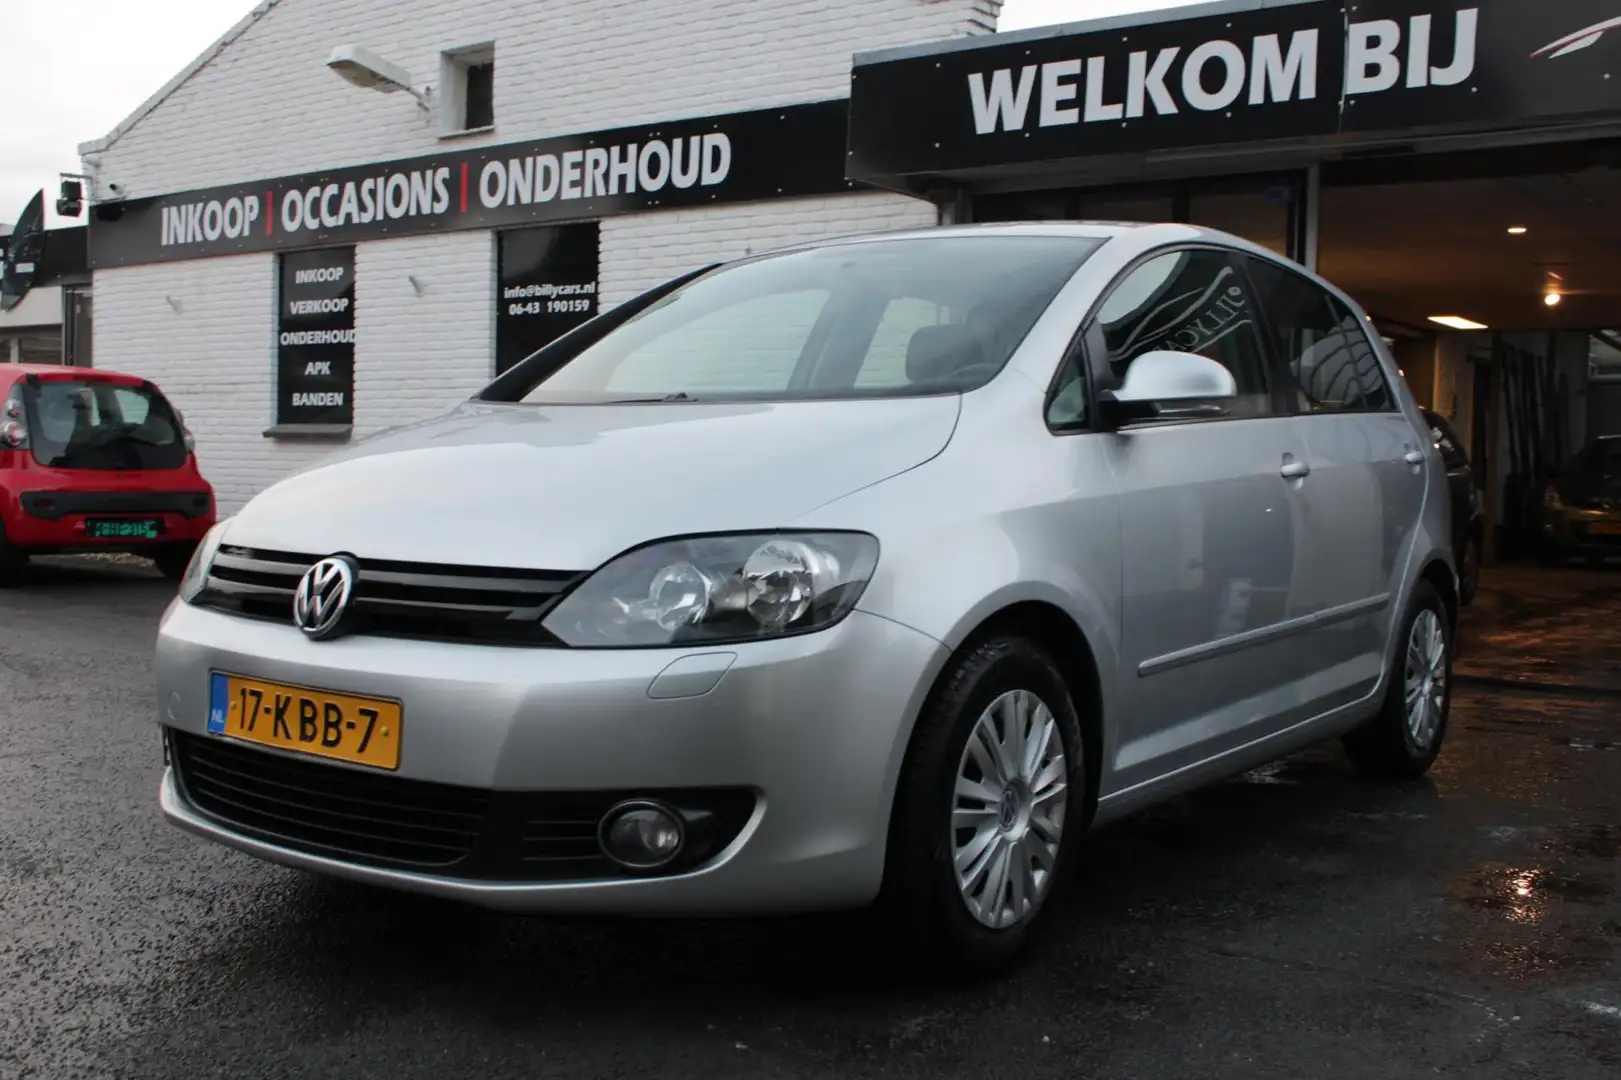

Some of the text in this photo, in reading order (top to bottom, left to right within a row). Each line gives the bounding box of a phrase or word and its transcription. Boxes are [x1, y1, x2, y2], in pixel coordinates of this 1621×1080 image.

[968, 7, 1479, 135] WELKOM BIJ
[160, 132, 732, 246] INKOOP OCCASIONS ONDERHOUD
[295, 266, 344, 284] INKOOP
[504, 281, 596, 299] info@billycars.nl
[290, 298, 349, 315] VERKOOP
[547, 299, 590, 314] 190159
[280, 329, 355, 345] ONDERHOUD
[304, 361, 331, 376] APK
[292, 392, 344, 406] BANDEN
[211, 708, 225, 724] NL
[239, 687, 380, 754] 17-KBB-7
